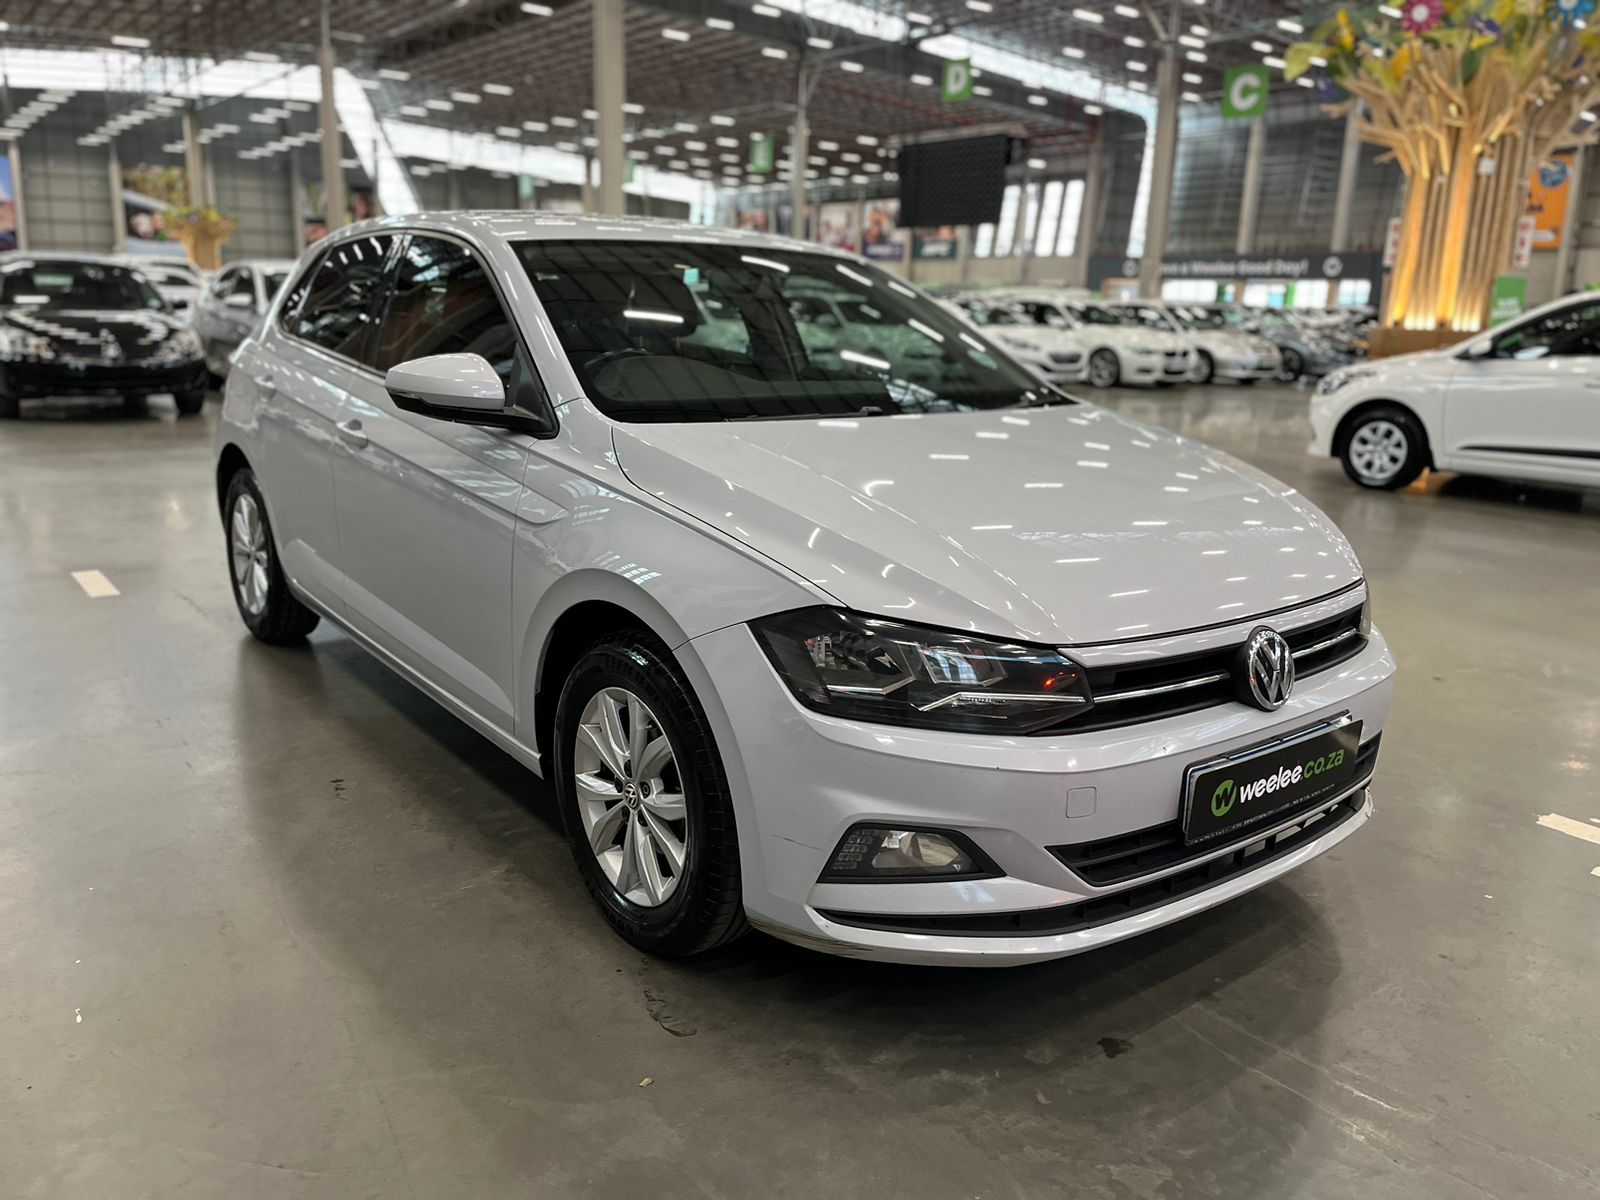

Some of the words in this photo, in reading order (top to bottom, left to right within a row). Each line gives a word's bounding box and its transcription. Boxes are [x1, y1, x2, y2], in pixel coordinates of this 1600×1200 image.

[946, 63, 968, 96] D
[1230, 72, 1261, 111] C
[1238, 259, 1271, 276] Good
[1239, 748, 1345, 803] weelee.co.za
